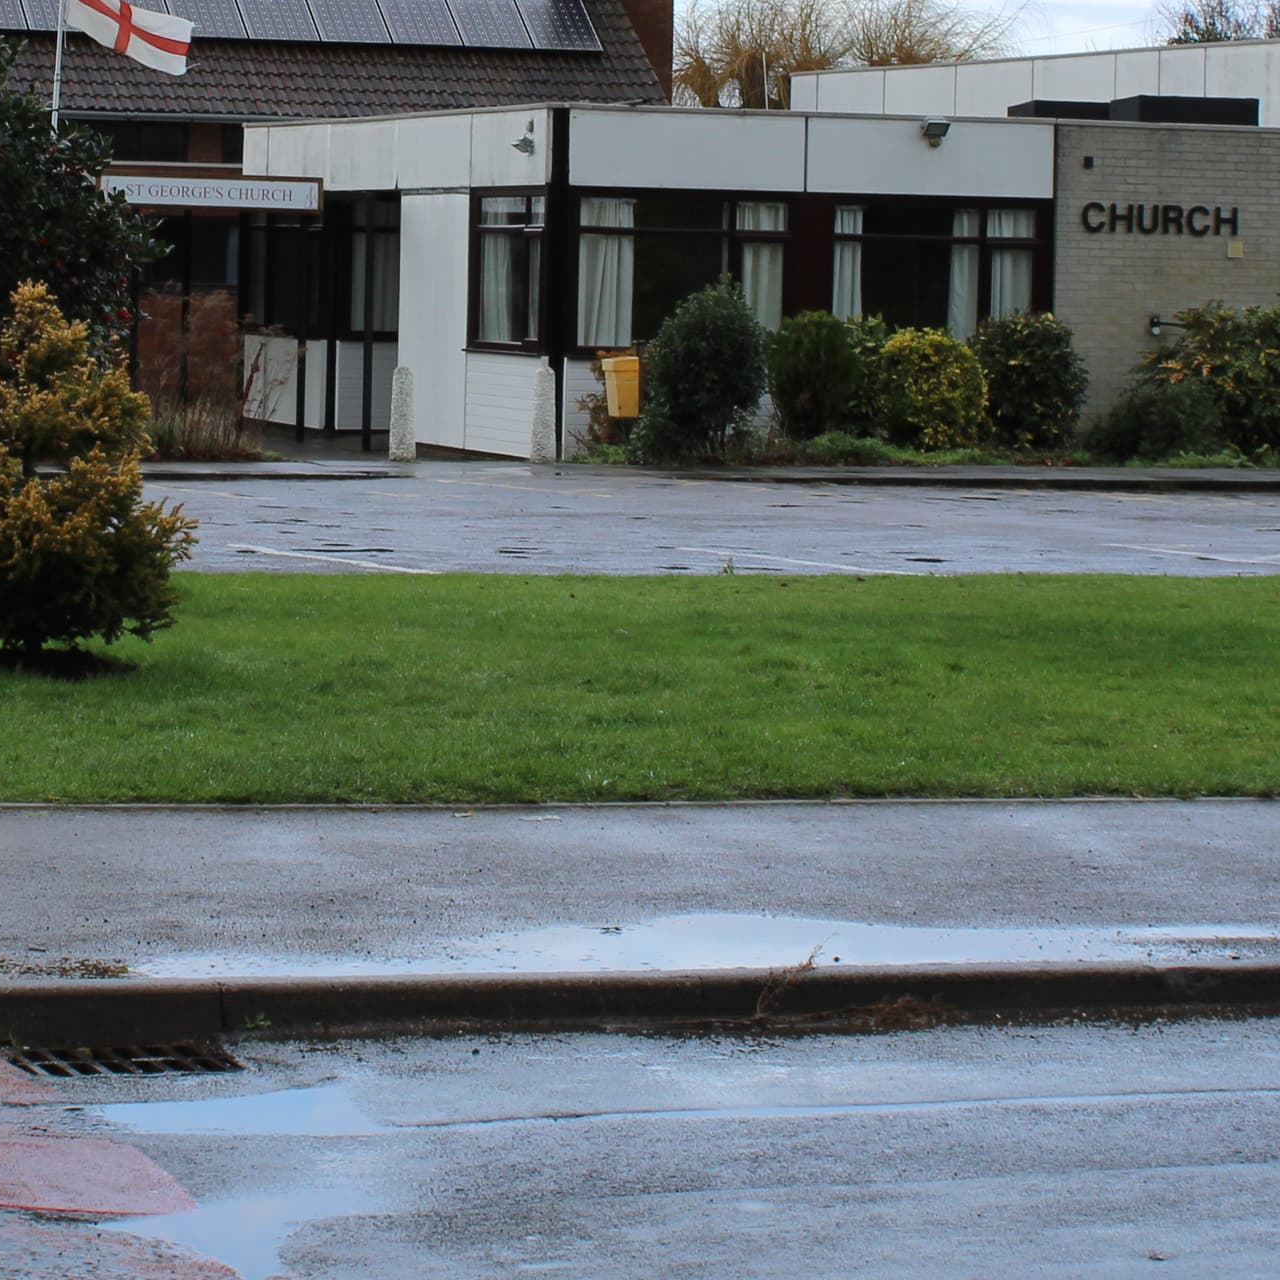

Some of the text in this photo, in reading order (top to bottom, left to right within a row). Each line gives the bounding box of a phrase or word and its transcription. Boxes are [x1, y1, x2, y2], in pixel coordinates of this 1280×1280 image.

[126, 183, 293, 202] ST GEORGE'S CHURCH
[1081, 202, 1239, 236] CHURCH
